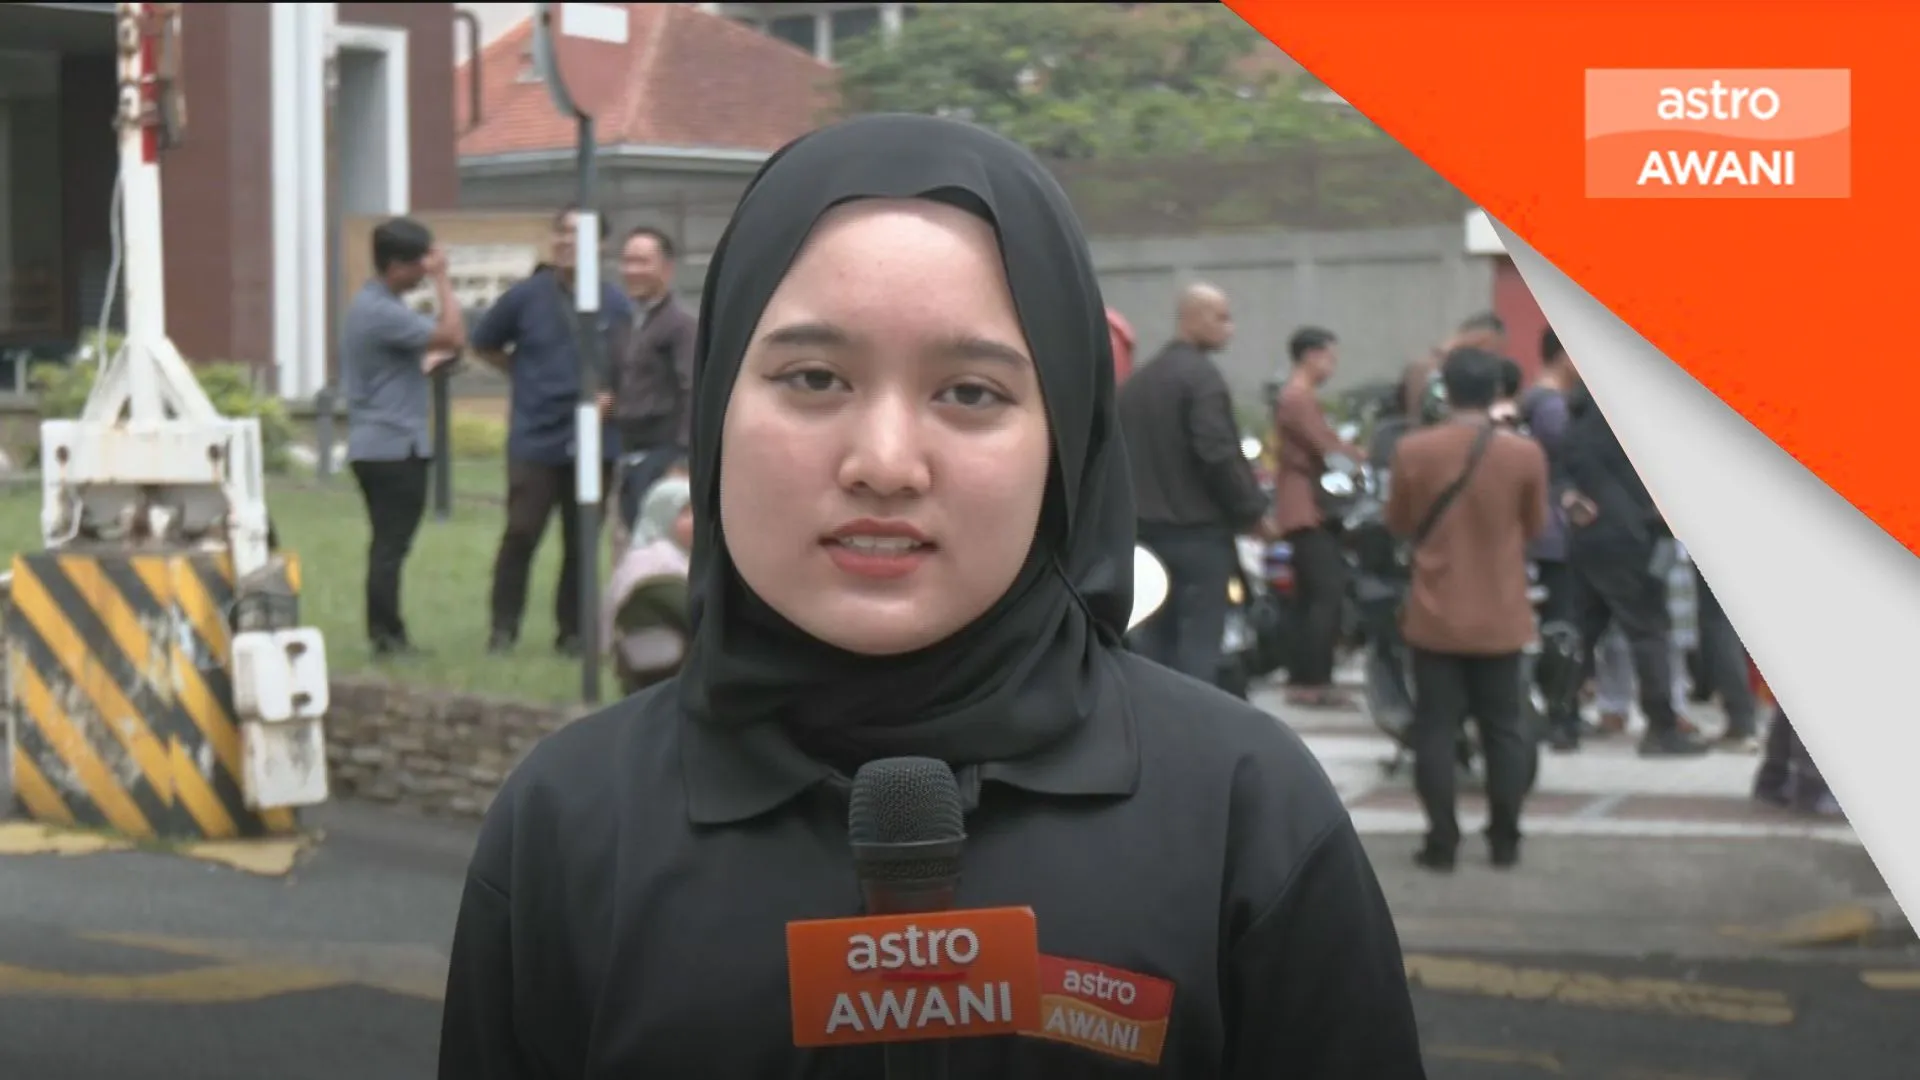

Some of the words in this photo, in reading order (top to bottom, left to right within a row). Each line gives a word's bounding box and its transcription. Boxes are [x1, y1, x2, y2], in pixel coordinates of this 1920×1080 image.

[847, 924, 979, 971] astro
[825, 981, 1012, 1034] AWANI
[1063, 969, 1136, 1006] astro
[1045, 1007, 1140, 1051] AWANI
